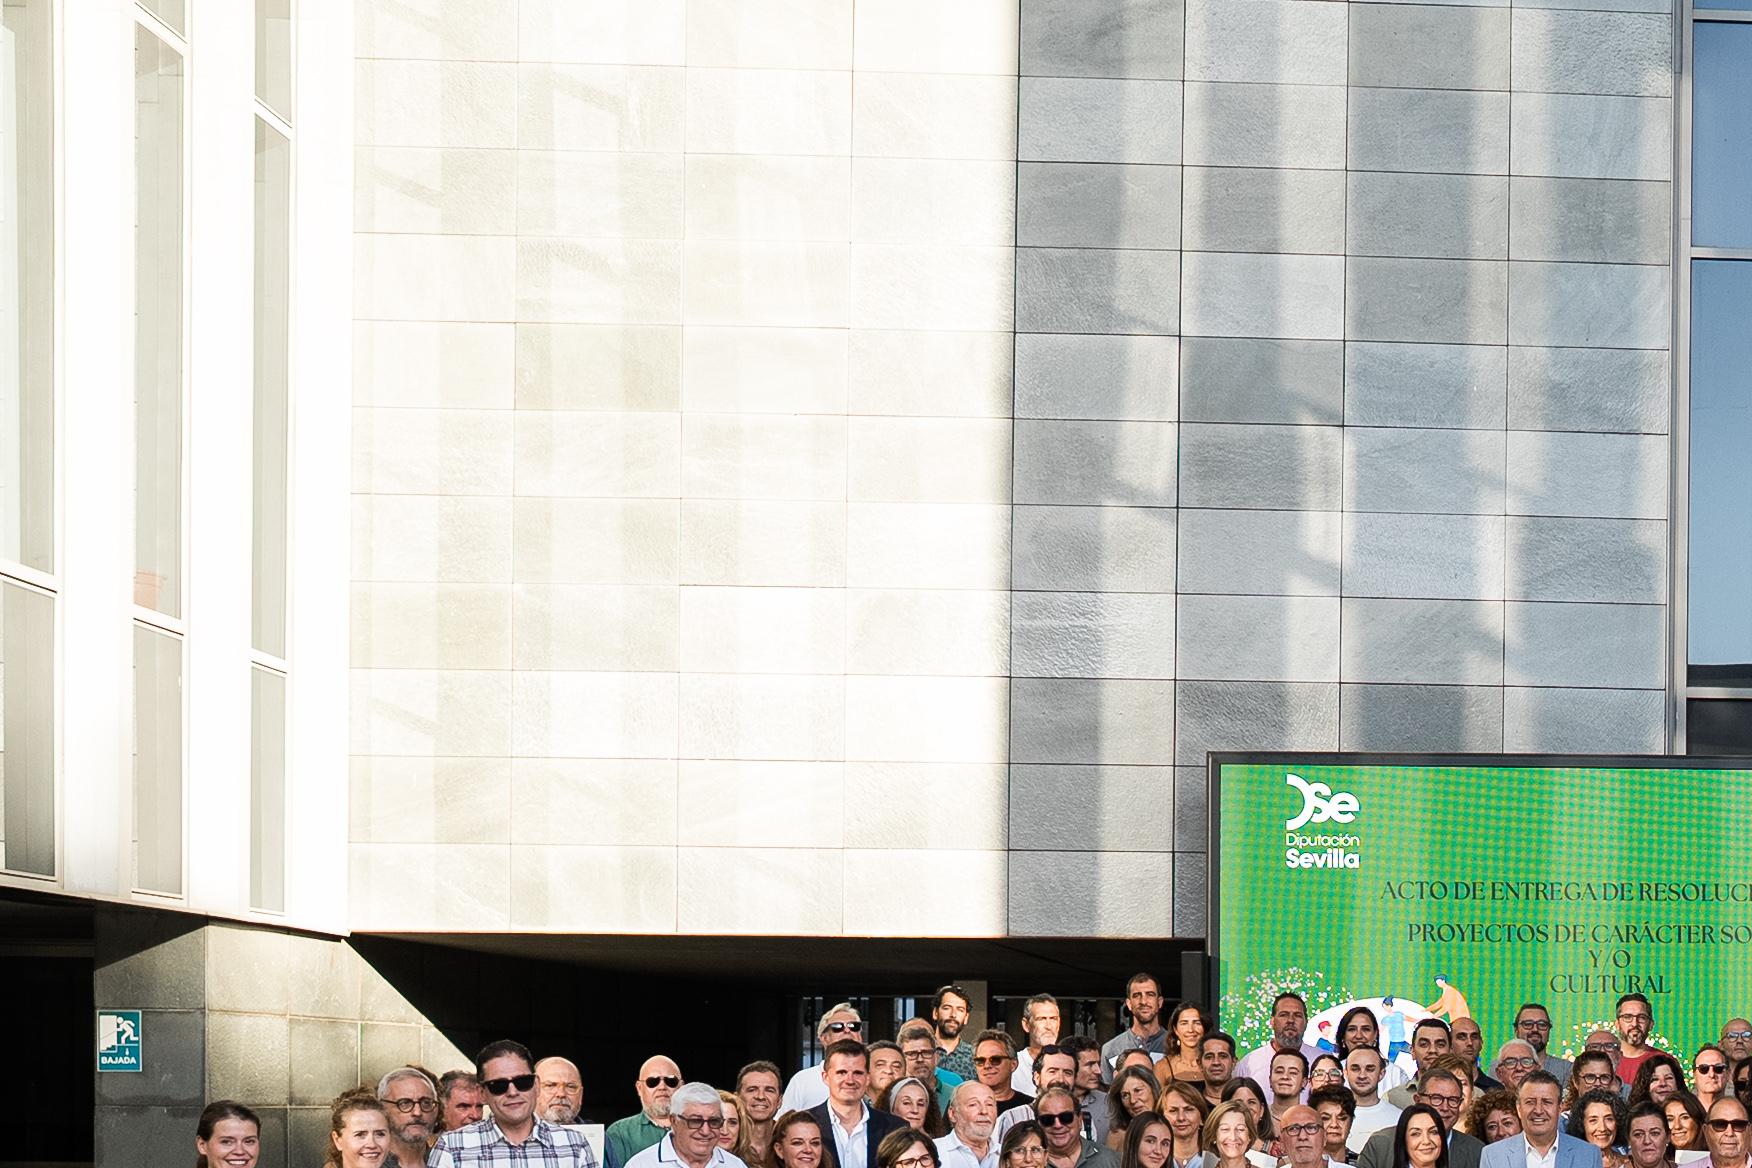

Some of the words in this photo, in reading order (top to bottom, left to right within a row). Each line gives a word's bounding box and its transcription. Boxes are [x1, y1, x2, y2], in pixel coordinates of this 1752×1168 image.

[1286, 832, 1360, 848] Diputación
[1286, 848, 1360, 869] Sevilla
[1381, 880, 1448, 900] ACTO
[1453, 881, 1486, 900] DE
[1491, 881, 1598, 901] ENTREGA
[1602, 882, 1633, 901] DE
[1408, 923, 1549, 943] PROYECTOS
[1555, 924, 1586, 943] DE
[1591, 921, 1715, 945] CARÁCTER
[1588, 947, 1631, 973] Y/O
[1550, 974, 1672, 995] CULTURAL
[101, 1056, 136, 1064] BAJADA
